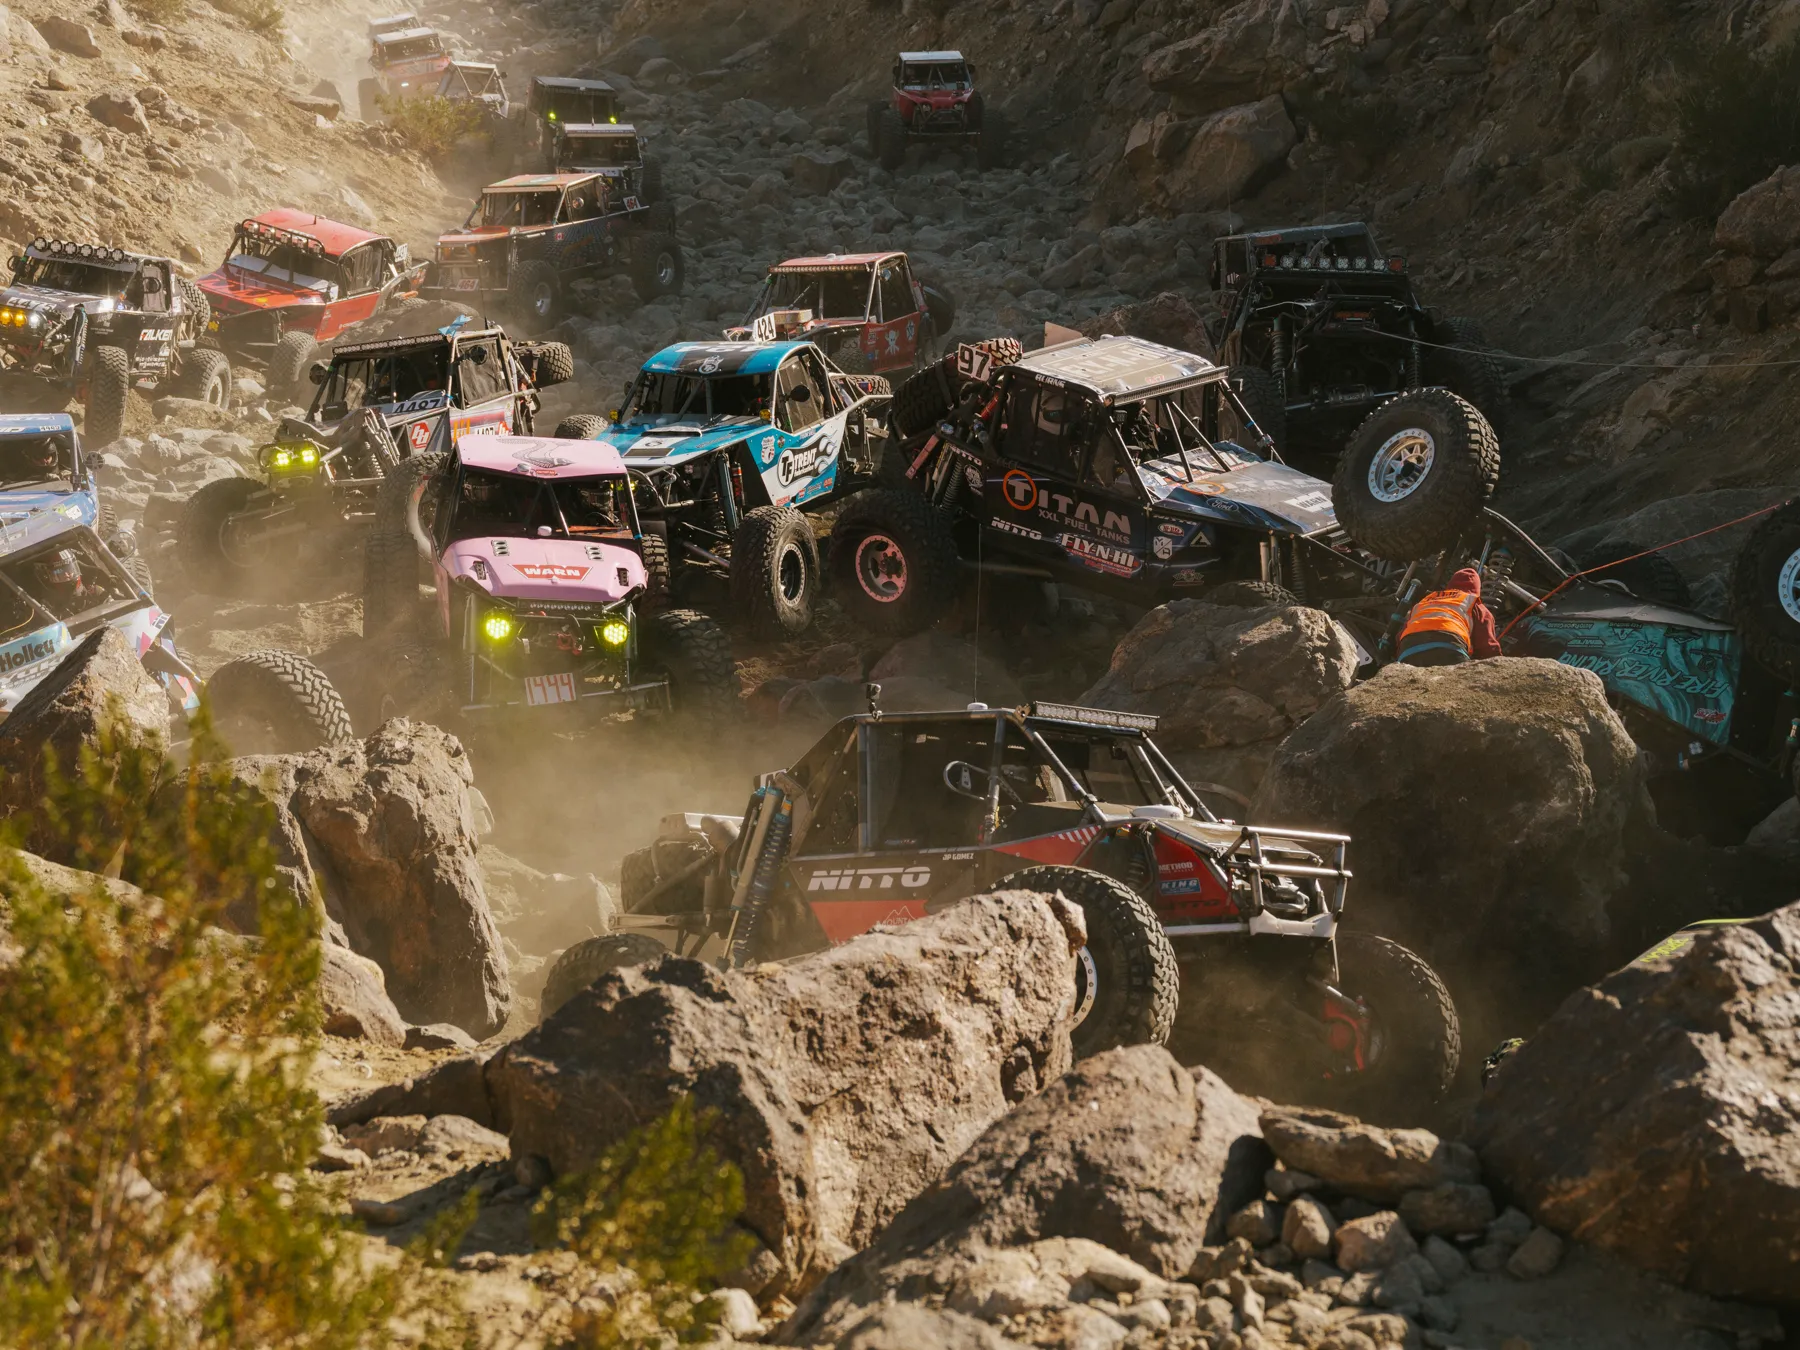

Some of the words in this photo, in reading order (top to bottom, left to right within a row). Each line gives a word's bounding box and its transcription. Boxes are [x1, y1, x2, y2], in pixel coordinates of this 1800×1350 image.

[757, 315, 775, 342] 424
[959, 346, 991, 379] 97
[394, 398, 441, 413] 4487
[781, 456, 793, 482] TF
[794, 448, 817, 470] TRENT
[1007, 479, 1132, 535] TITAN
[1211, 500, 1233, 511] Ford
[1297, 496, 1330, 509] WARN
[991, 516, 1042, 541] NITTO
[1038, 509, 1060, 523] XXL
[1064, 517, 1091, 532] FUEL
[1096, 527, 1130, 545] TANKS
[1061, 533, 1135, 568] FLY-N-HI
[524, 567, 581, 577] WARN
[1616, 657, 1686, 687] RIVER
[1673, 675, 1731, 699] FIRE
[953, 852, 975, 860] GOMEZ
[1158, 862, 1194, 872] METHOD
[808, 866, 931, 890] NITTO
[1160, 880, 1198, 890] KING
